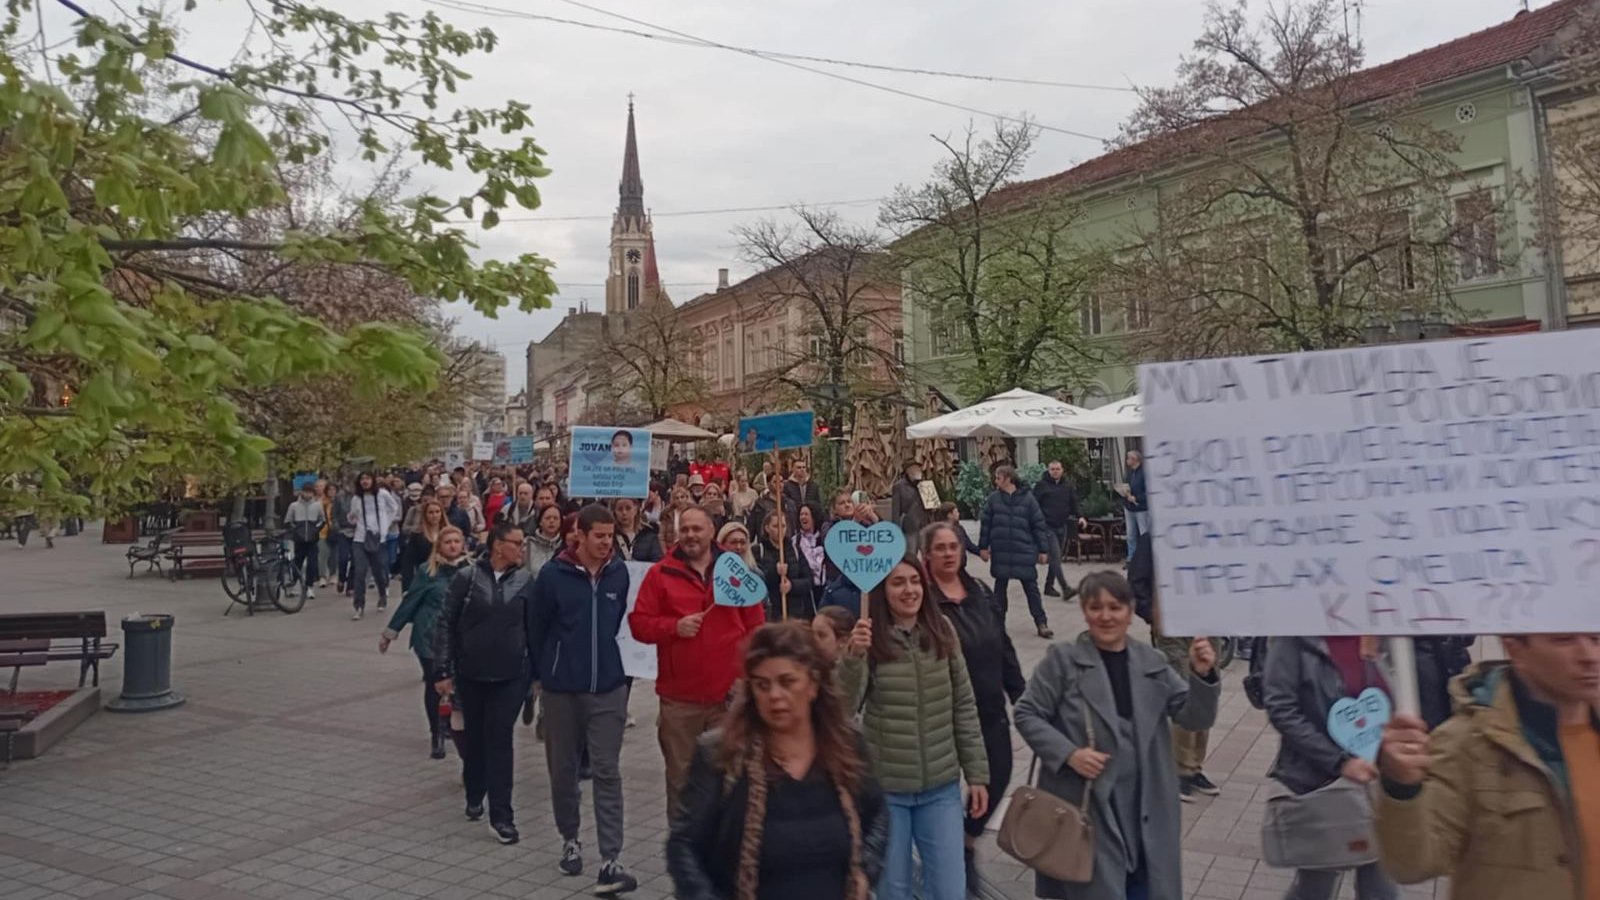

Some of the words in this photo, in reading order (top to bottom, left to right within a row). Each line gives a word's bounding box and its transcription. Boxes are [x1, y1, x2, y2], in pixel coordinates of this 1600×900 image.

[1012, 405, 1078, 417] rosa
[579, 442, 612, 452] JOVAN
[839, 529, 895, 543] ПЕРЛЕЗ
[842, 557, 893, 573] АУТИЗАМ
[724, 556, 759, 593] ПЕРЛЕЗ
[715, 575, 746, 606] АУТИЗАМ
